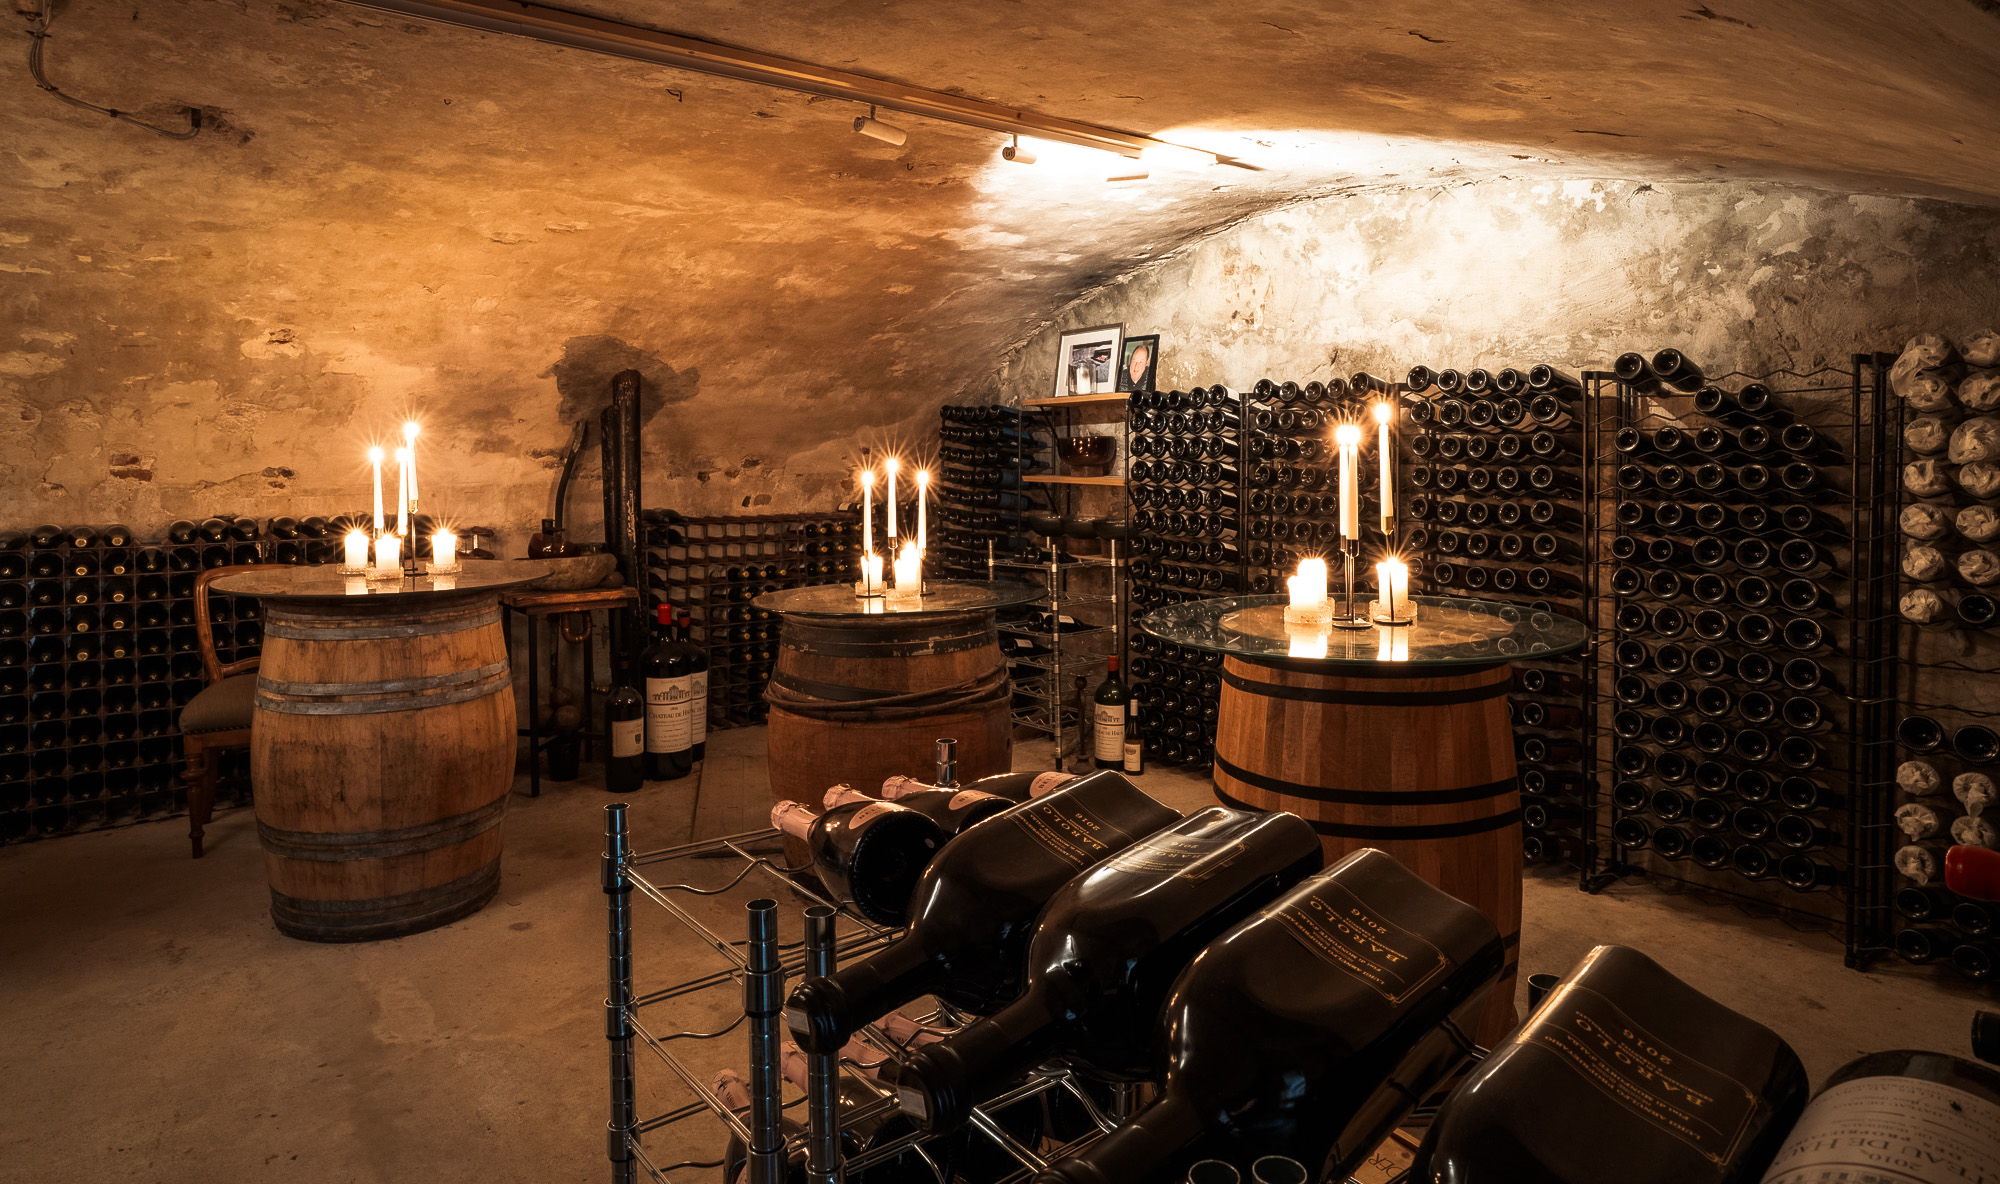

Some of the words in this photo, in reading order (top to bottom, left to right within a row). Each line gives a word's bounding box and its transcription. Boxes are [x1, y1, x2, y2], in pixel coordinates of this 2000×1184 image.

[1042, 805, 1102, 850] BAROLO
[1074, 812, 1100, 831] 2016
[1279, 910, 1327, 950] PROPRIETARIO
[1297, 911, 1319, 931] d'ALBA
[1309, 899, 1400, 962] BAROLO
[1350, 907, 1387, 933] 2016
[1319, 930, 1357, 959] MONFORTE
[1327, 949, 1361, 972] ARNULFO
[1362, 970, 1384, 985] LUIGI
[1566, 1034, 1598, 1062] d'ALBA
[1621, 1028, 1673, 1066] 2016
[1544, 1034, 1615, 1089] PROPRIETARIO
[1574, 1017, 1704, 1106] BAROLO
[1597, 1061, 1655, 1102] MONFORTE
[1615, 1088, 1667, 1121] ARNULFO
[1654, 1099, 1667, 1109] di
[1668, 1107, 1689, 1121] Fini
[1668, 1119, 1701, 1140] LUIGI
[1849, 1136, 1889, 1149] DE
[1869, 1153, 1921, 1171] 2010
